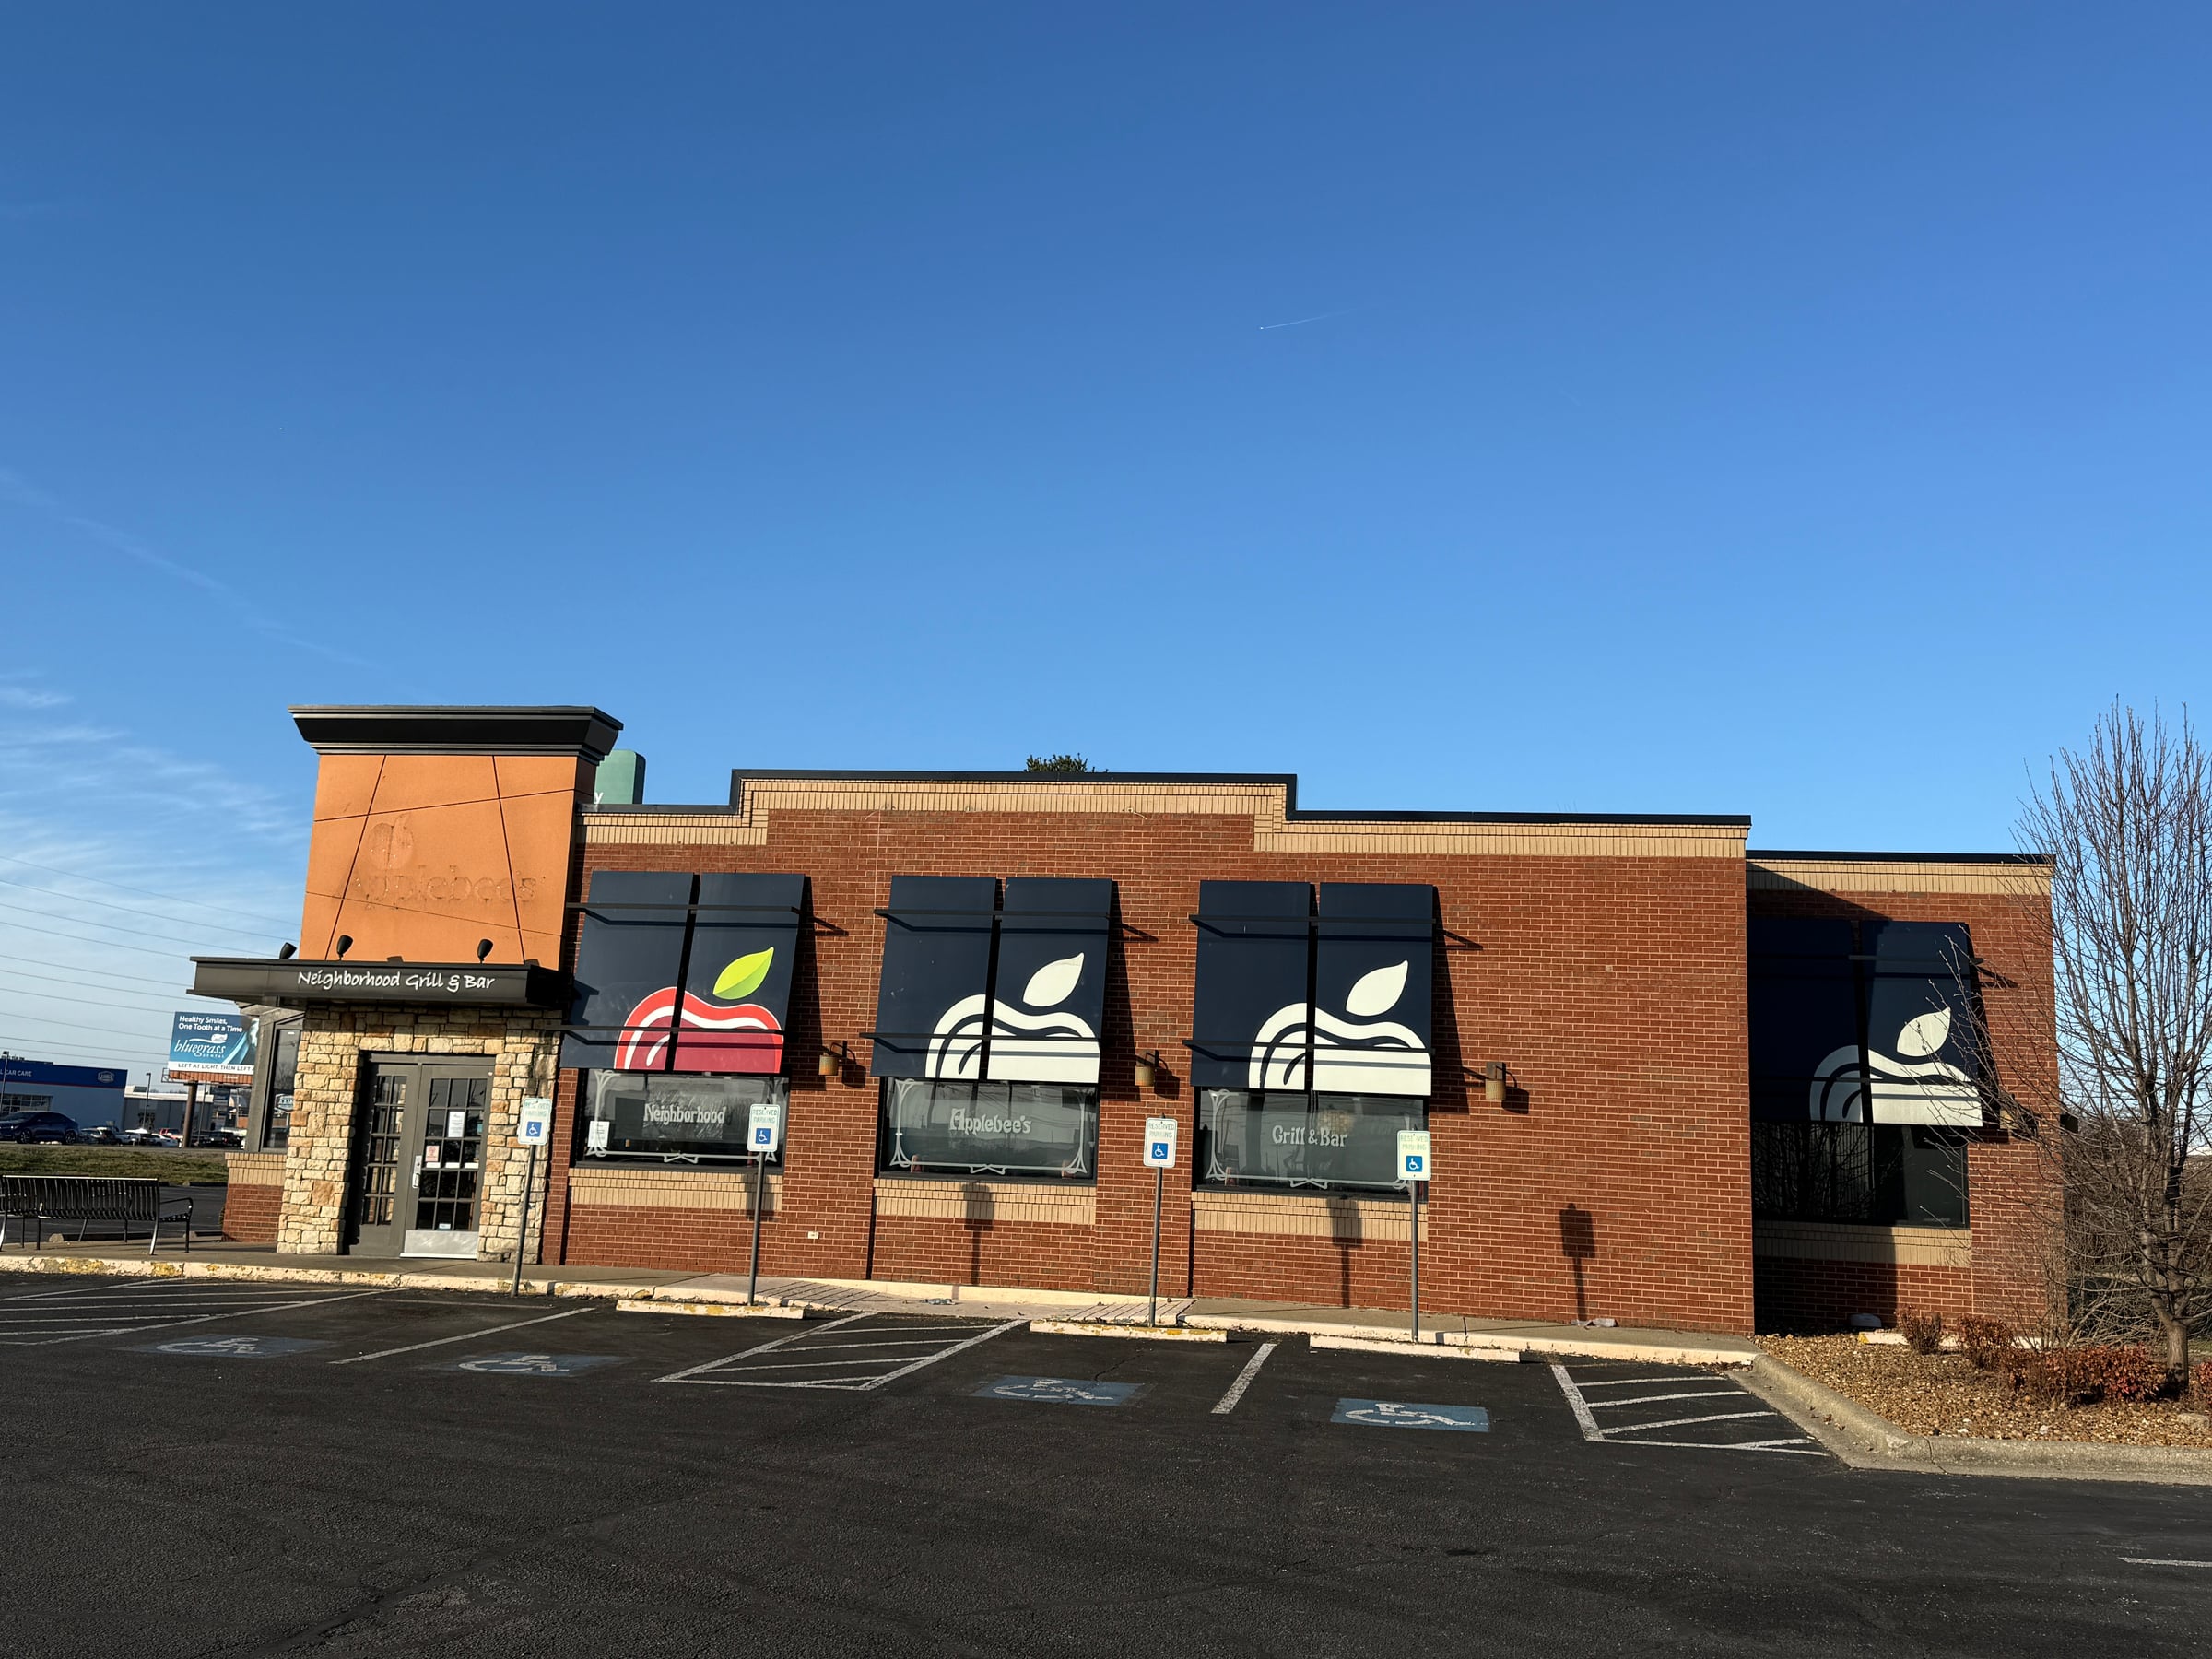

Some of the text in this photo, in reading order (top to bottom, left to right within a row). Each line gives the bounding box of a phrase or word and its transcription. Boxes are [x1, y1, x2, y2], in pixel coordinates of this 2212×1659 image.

[297, 970, 496, 993] Neighborhood Grill & Bar
[179, 1016, 228, 1025] Healthy Smiles,
[194, 1023, 213, 1031] Tooth
[173, 1039, 226, 1057] bluegrass
[643, 1103, 726, 1125] Neighborhood
[948, 1107, 1031, 1135] Applebee's
[1272, 1124, 1348, 1147] Grill & Bar
